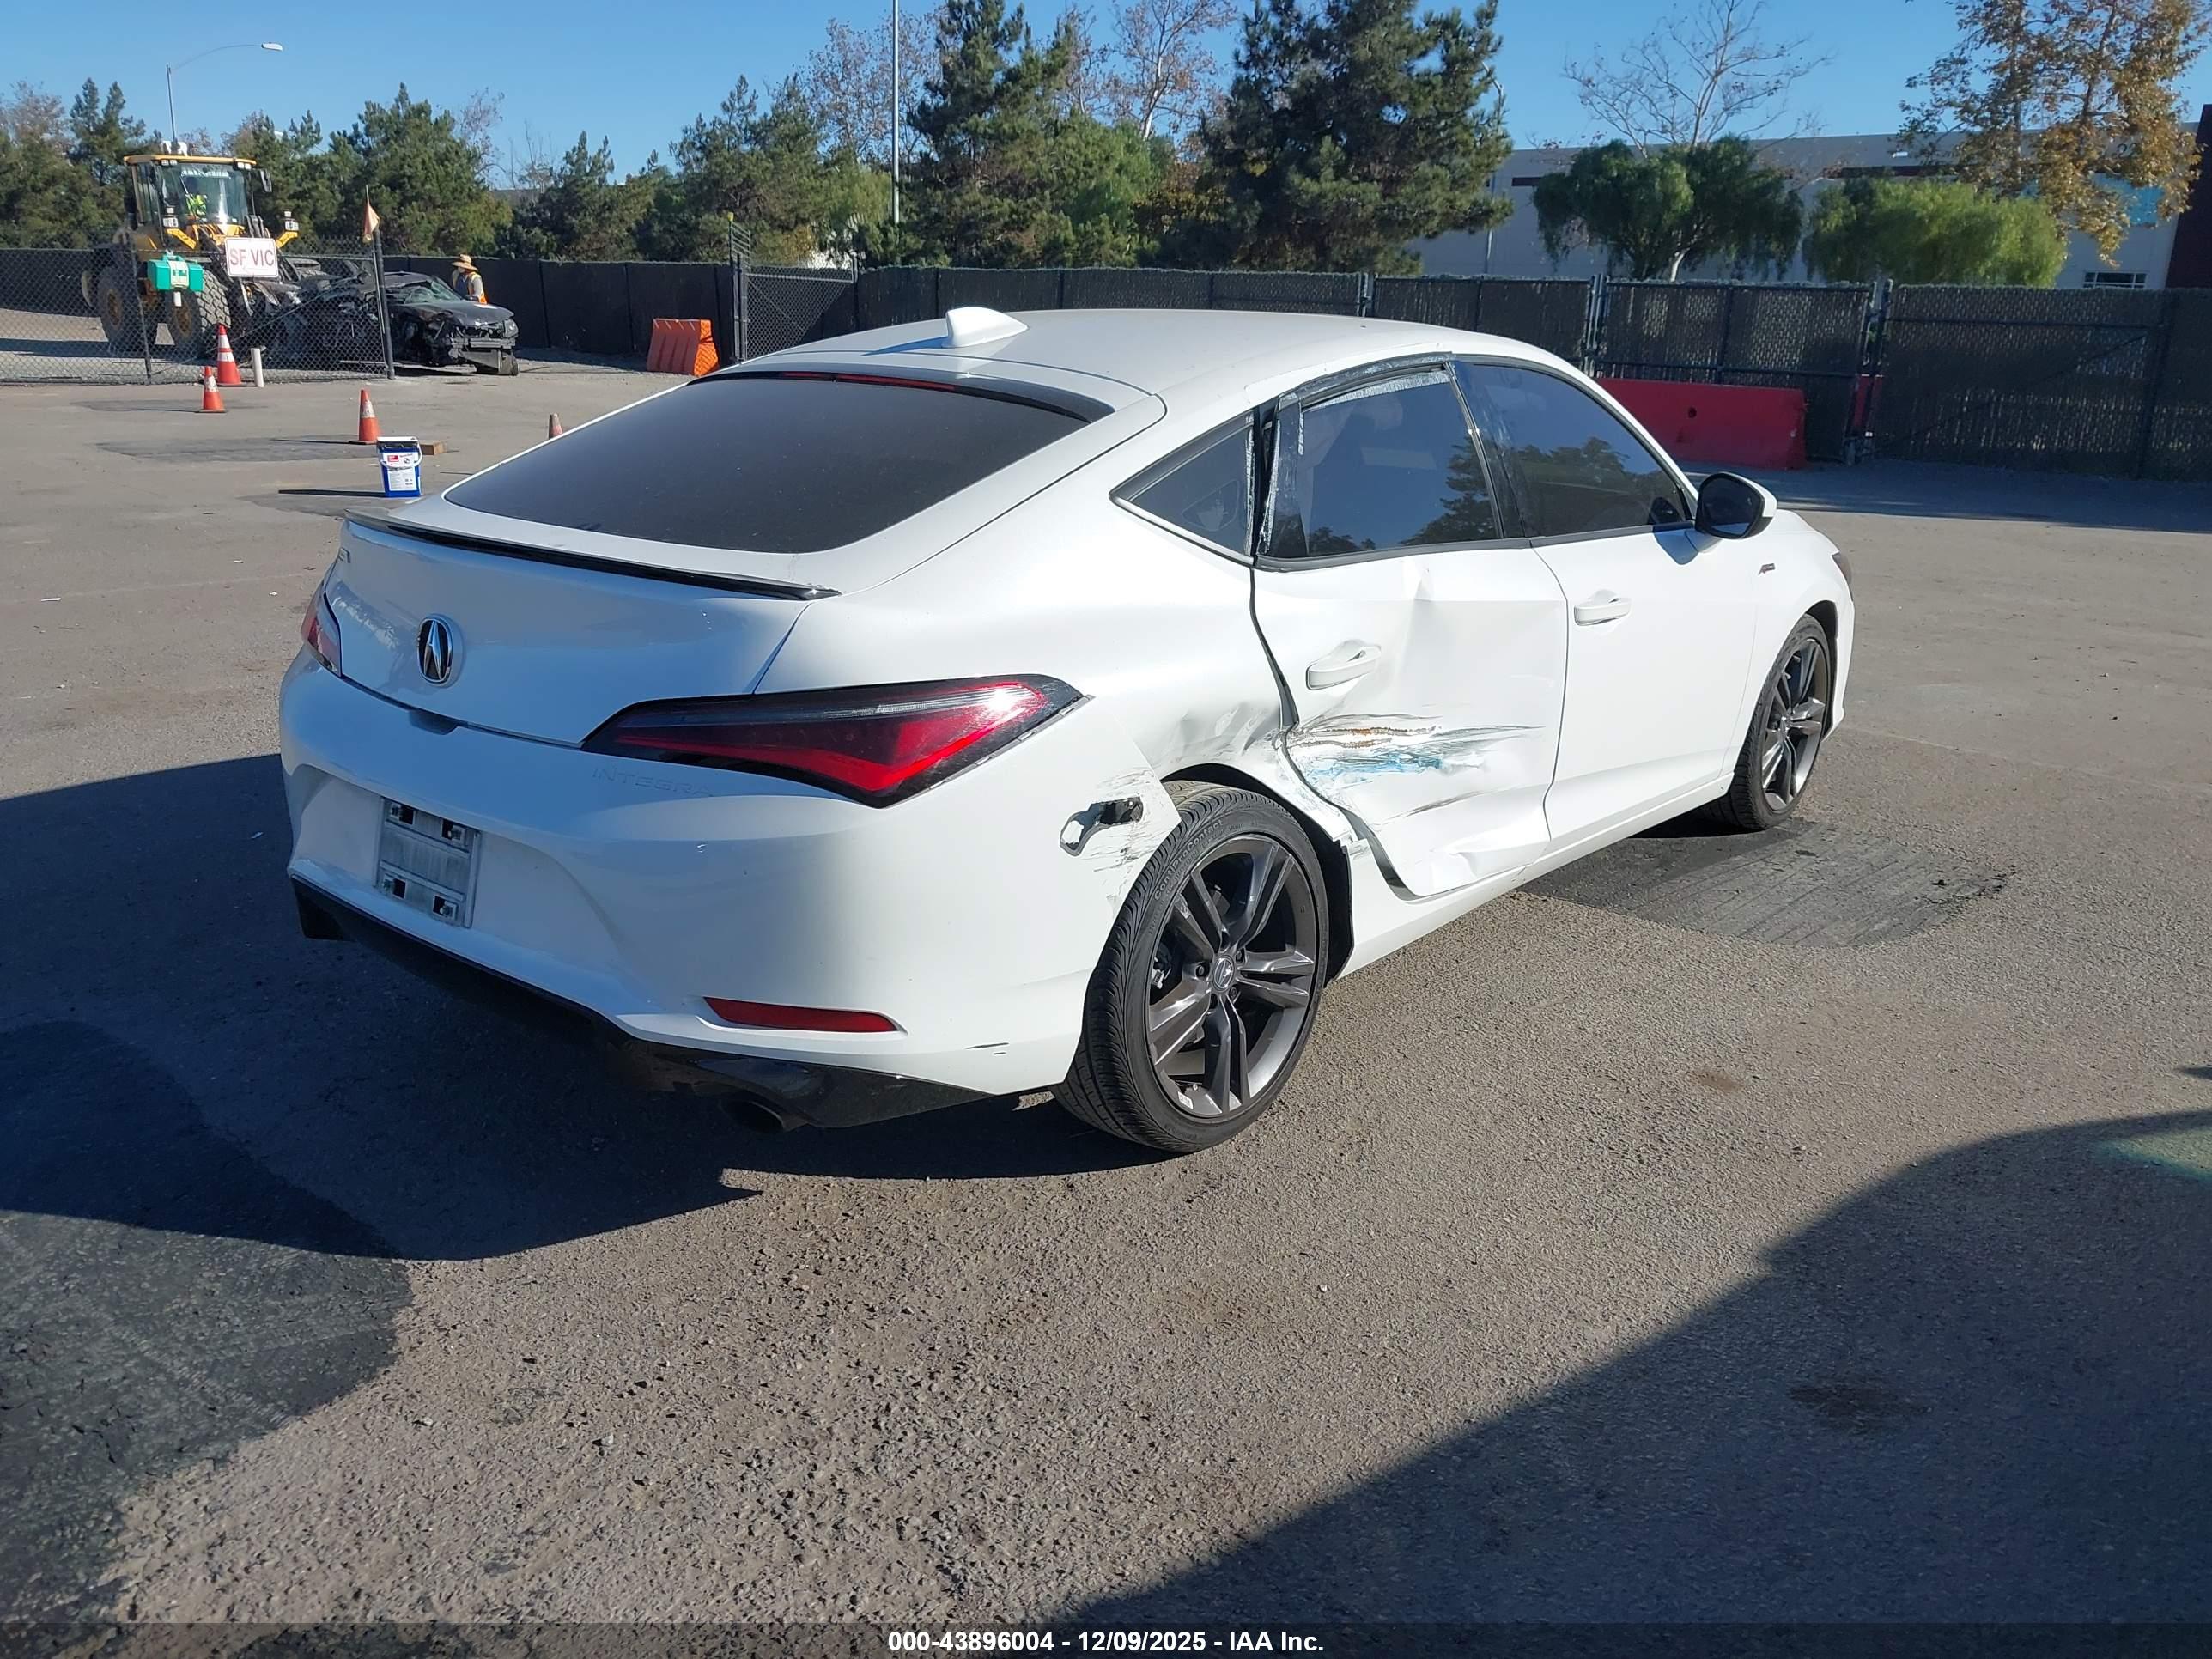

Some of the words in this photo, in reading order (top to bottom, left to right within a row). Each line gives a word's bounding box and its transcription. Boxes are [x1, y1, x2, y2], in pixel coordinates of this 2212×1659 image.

[229, 247, 246, 266] SF
[250, 248, 275, 267] VIC
[592, 768, 714, 798] INTEGRA
